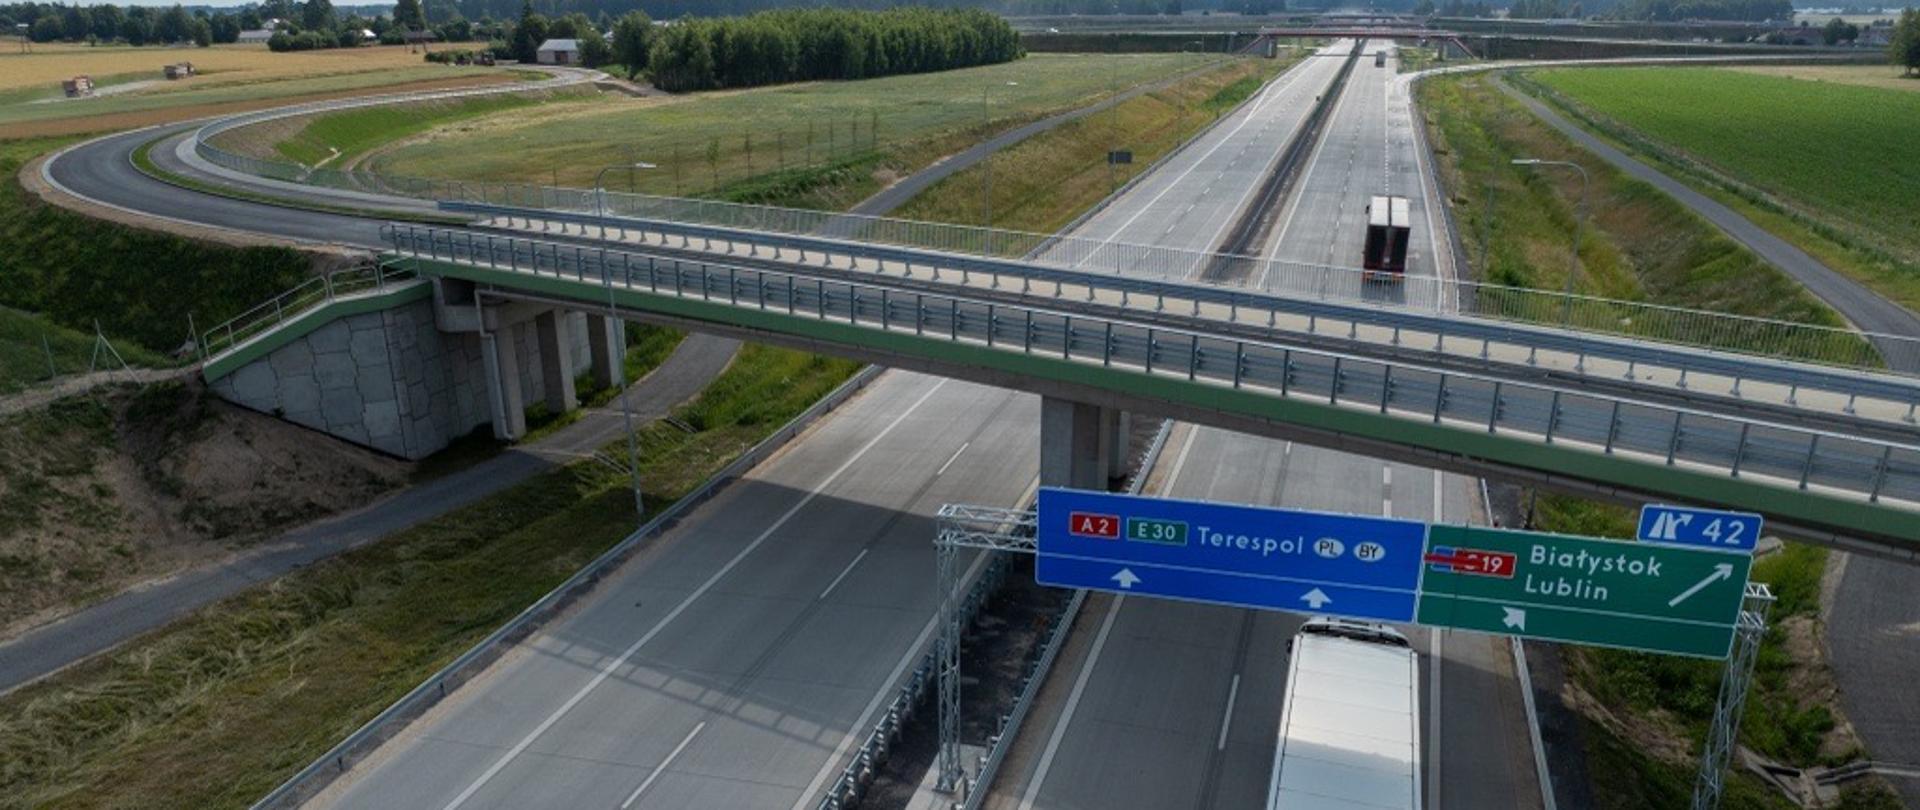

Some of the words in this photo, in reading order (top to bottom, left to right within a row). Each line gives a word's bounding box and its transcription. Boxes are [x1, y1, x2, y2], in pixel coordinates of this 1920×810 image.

[1198, 526, 1304, 557] Terespol
[1702, 519, 1745, 544] 42
[1319, 540, 1338, 556] PL
[1358, 544, 1379, 559] BY
[1529, 545, 1663, 577] Białystok
[1525, 574, 1608, 600] Lublin
